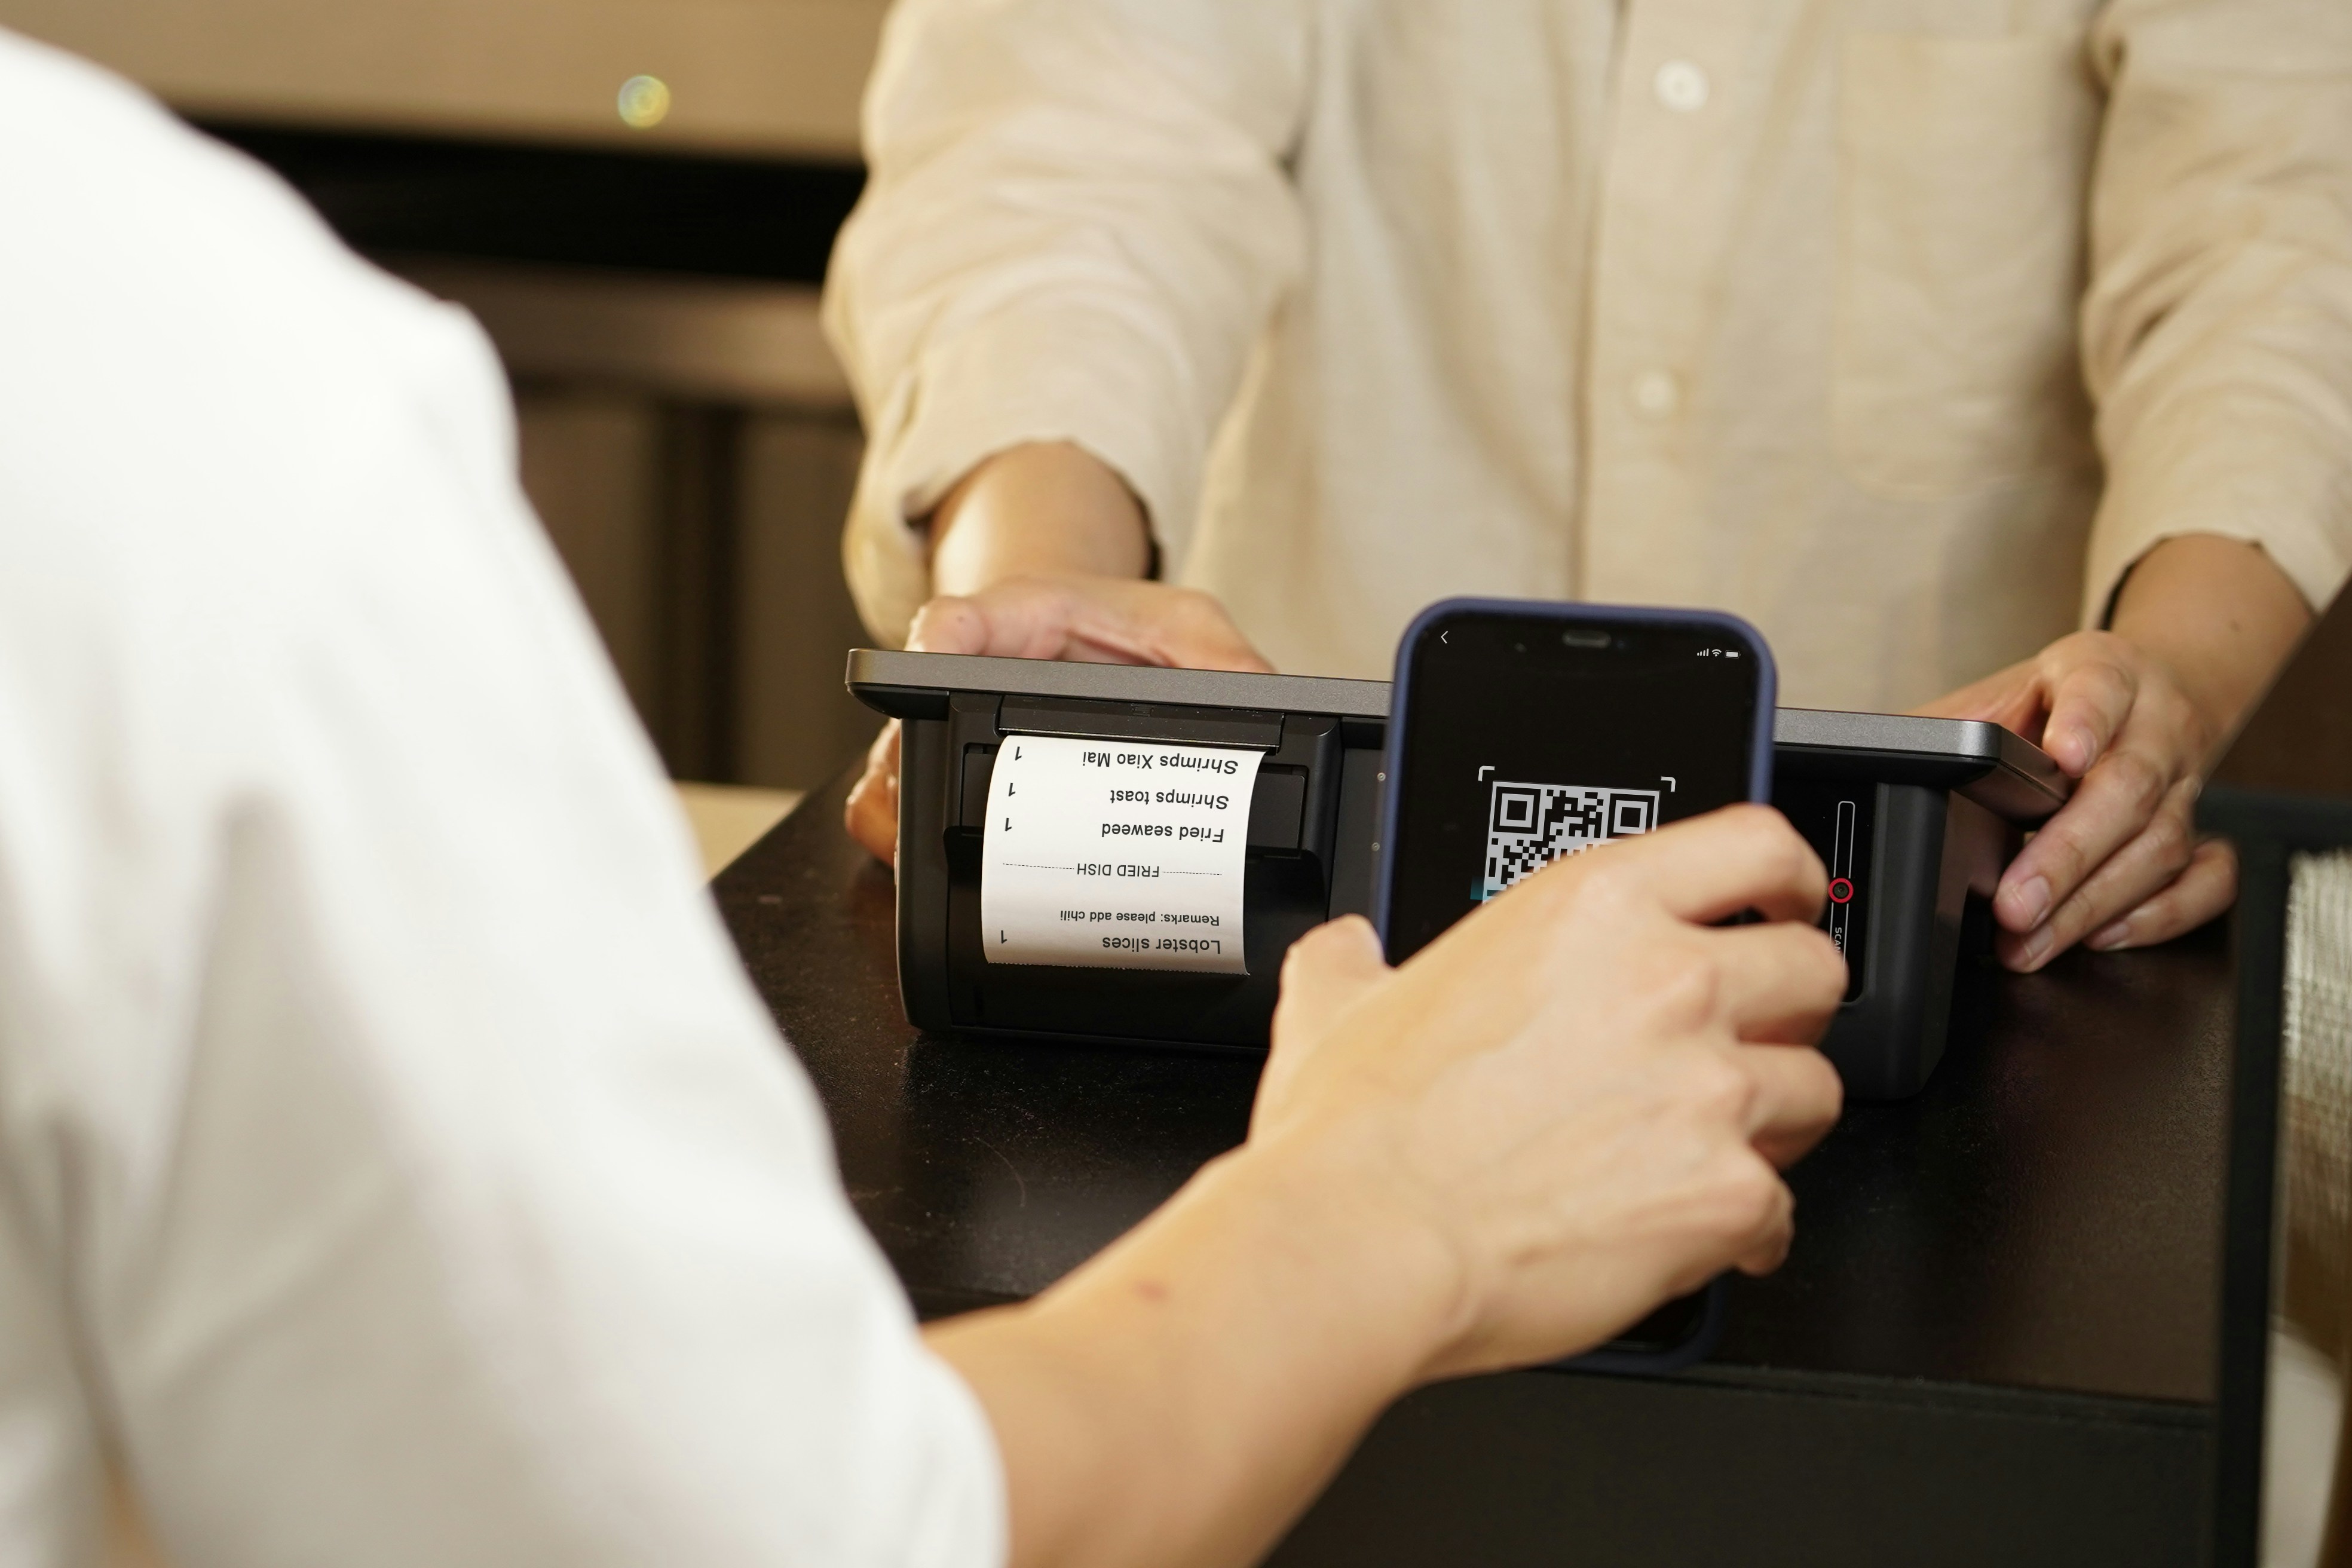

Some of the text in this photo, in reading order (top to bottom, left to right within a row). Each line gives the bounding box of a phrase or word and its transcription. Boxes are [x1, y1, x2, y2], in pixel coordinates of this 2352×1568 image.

[1014, 746, 1239, 775] Shrimps Xiao Mai 1
[1008, 782, 1229, 810] Shrimps toast 1
[1004, 817, 1224, 843] Fried seaweed 1
[1077, 863, 1160, 878] FRIED DISH
[1060, 910, 1220, 926] Remarks: please add chili
[1000, 930, 1221, 954] Lobster slices 1
